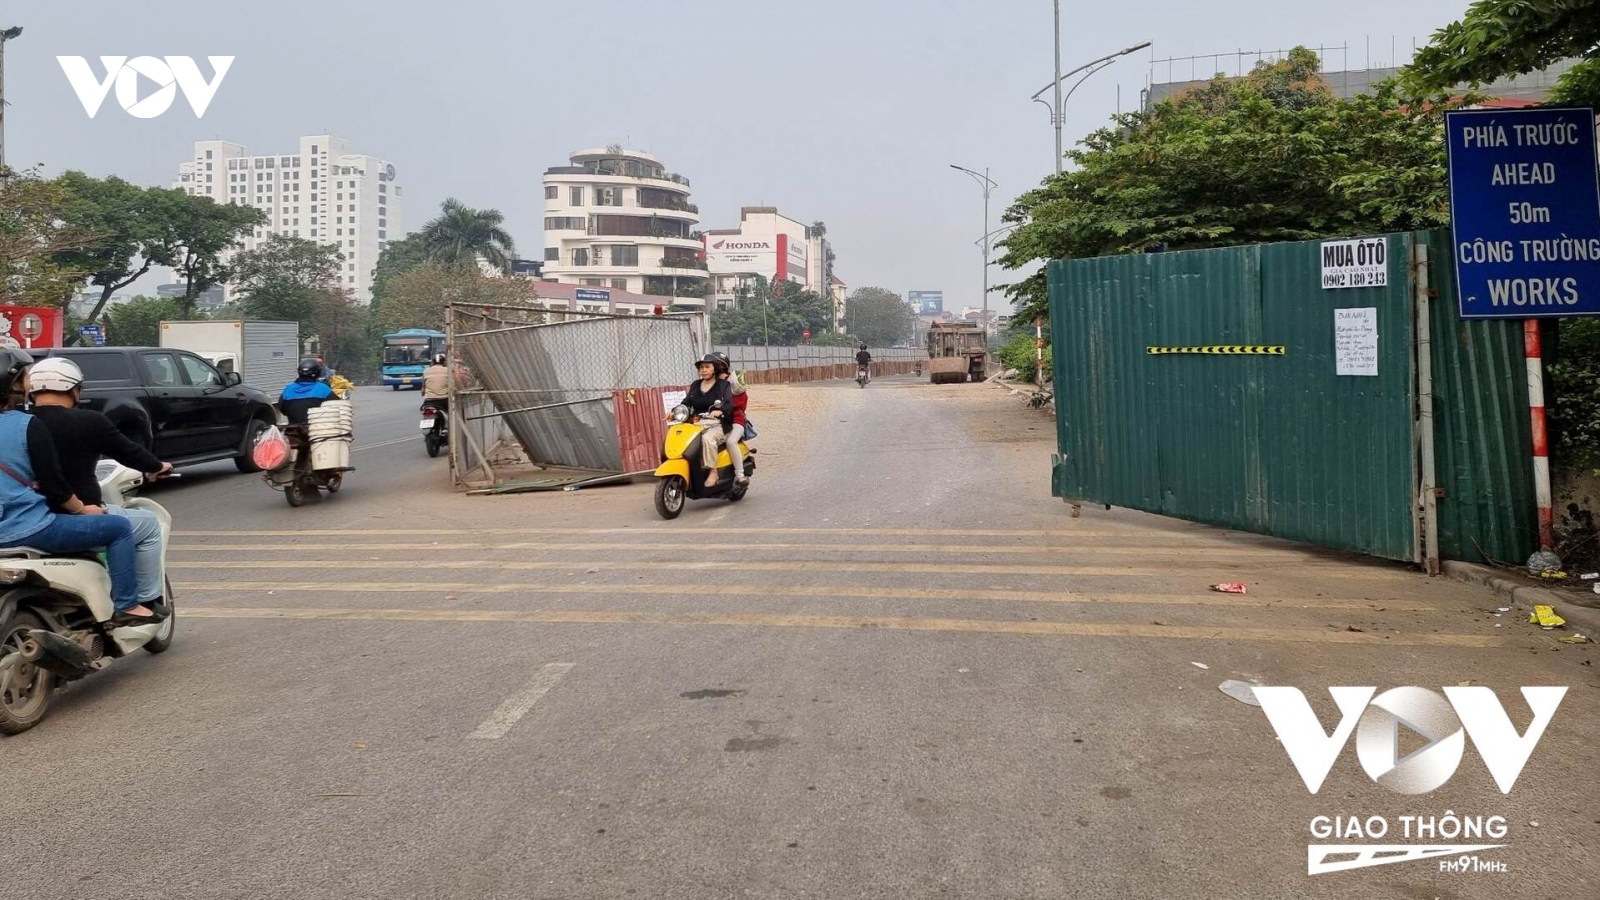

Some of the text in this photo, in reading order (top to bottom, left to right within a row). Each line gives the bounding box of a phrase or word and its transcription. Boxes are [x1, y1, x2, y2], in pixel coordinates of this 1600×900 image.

[1463, 116, 1579, 148] PHÍA TRƯỚC
[1491, 162, 1555, 185] AHEAD
[1509, 202, 1550, 224] 50m
[1323, 239, 1385, 268] MUA ÔTÔ
[1460, 233, 1600, 264] CÔNG TRƯỜNG
[1323, 272, 1385, 287] 0902 180 243
[1487, 277, 1579, 306] WORKS
